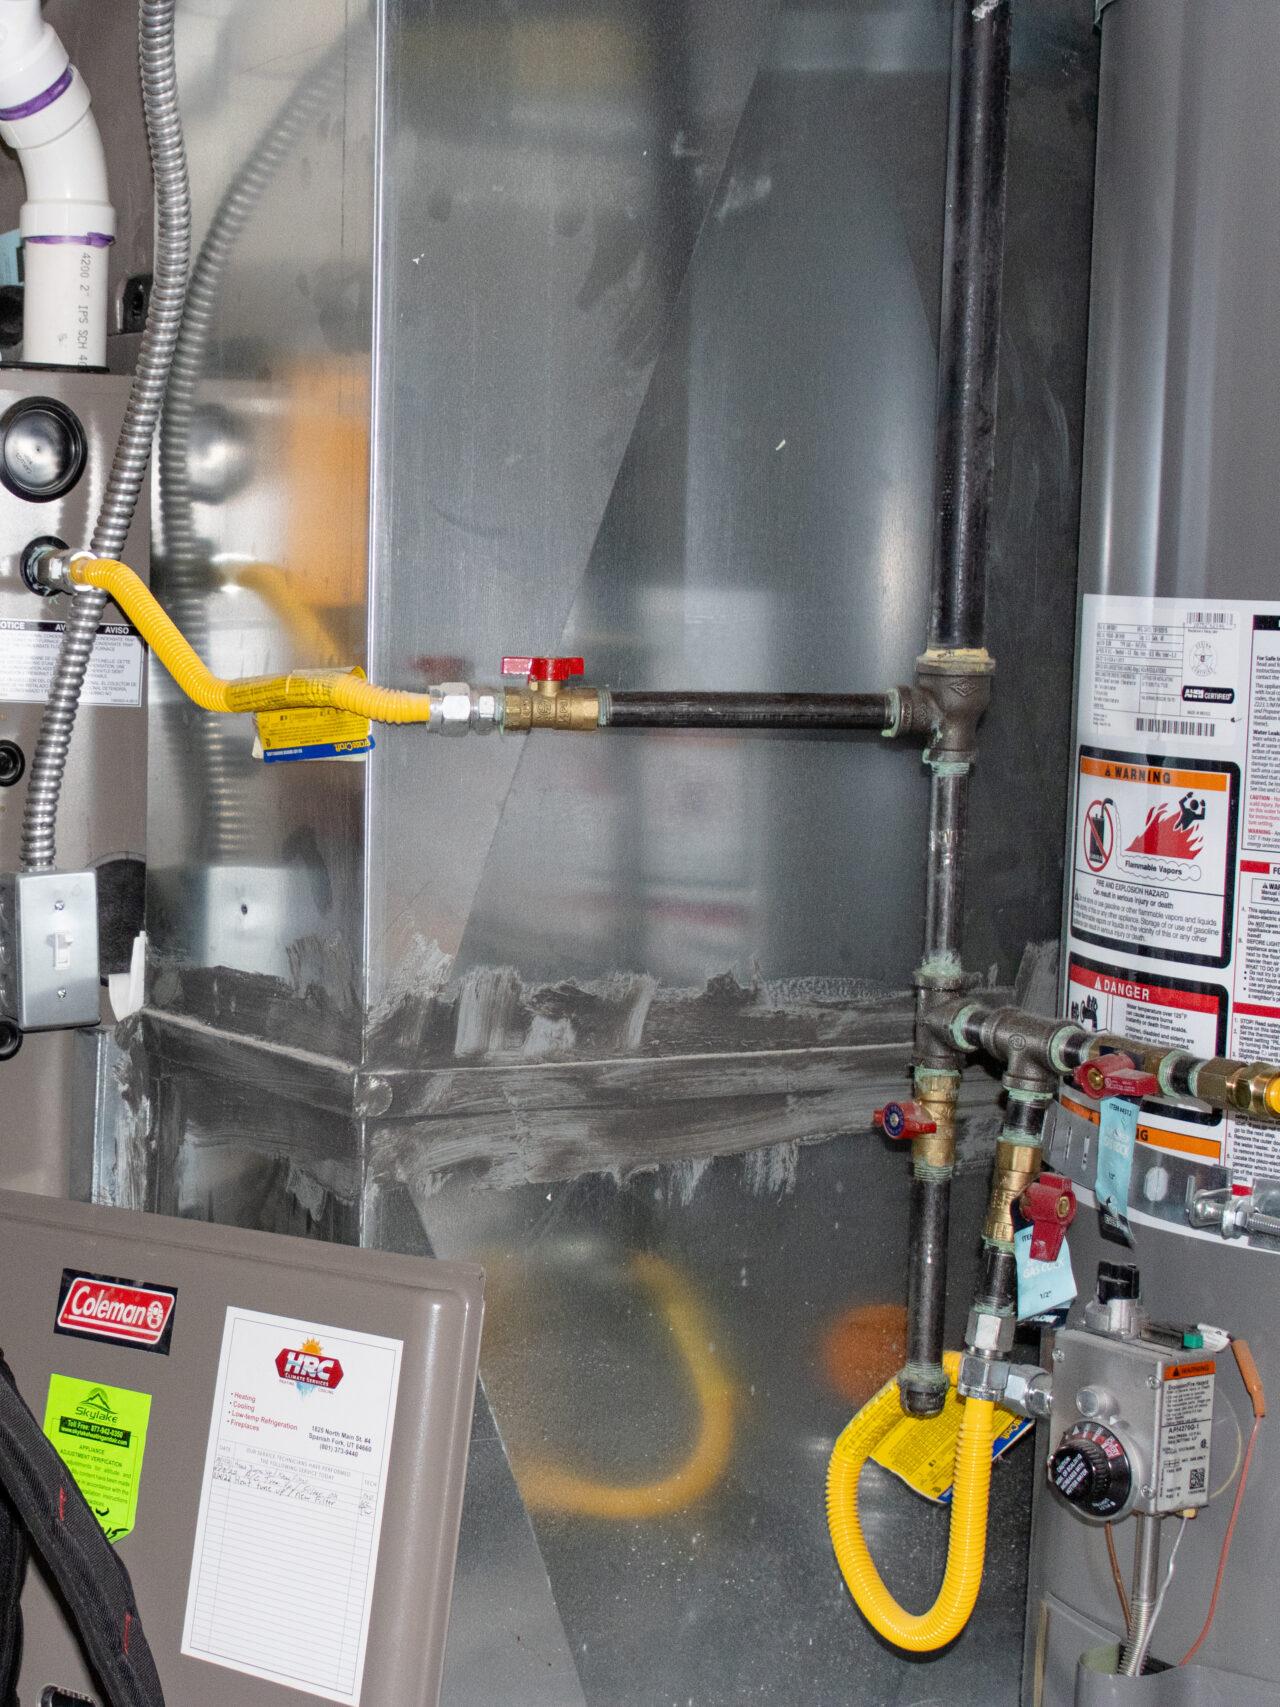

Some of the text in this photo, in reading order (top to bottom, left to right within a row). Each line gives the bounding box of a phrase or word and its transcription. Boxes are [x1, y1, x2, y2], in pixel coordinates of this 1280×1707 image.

[80, 252, 91, 278] 4200
[78, 305, 88, 324] IPS
[77, 330, 88, 349] SCH
[105, 626, 129, 634] AVISO
[1204, 690, 1230, 700] CERTIFIED
[1114, 764, 1171, 784] WARNING
[1125, 860, 1182, 876] Flammable Vapors
[1096, 879, 1104, 887] FIRE
[1115, 883, 1143, 894] EXPLOSION
[1145, 888, 1169, 898] HAZARD
[1135, 897, 1148, 907] injury
[1158, 901, 1173, 909] death
[1139, 909, 1163, 919] flammable
[1165, 914, 1183, 922] vapors
[1185, 916, 1196, 924] and
[1197, 917, 1216, 926] liquids
[1140, 917, 1160, 928] Storage
[1194, 927, 1219, 936] gasoline
[1162, 930, 1171, 938] this
[1180, 934, 1190, 942] any
[1104, 979, 1150, 1001] DANGER
[1138, 1005, 1162, 1014] temperature
[1143, 1028, 1160, 1037] disabled
[1170, 1034, 1186, 1043] elderly
[1040, 1290, 1052, 1299] 1/2"
[71, 1285, 146, 1326] Coleman
[284, 1352, 335, 1380] HRC
[1181, 1364, 1210, 1374] WARNING
[285, 1373, 329, 1386] CLIMATE SERVICES
[234, 1392, 256, 1403] Heating
[233, 1401, 255, 1412] Cooling
[75, 1406, 118, 1423] Skylake
[232, 1410, 297, 1430] Low-temp Refrigeration
[68, 1419, 77, 1427] Toll
[230, 1419, 259, 1431] Fireplaces
[309, 1433, 330, 1442] Spanish
[325, 1428, 340, 1437] North
[341, 1432, 354, 1440] Main
[80, 1444, 104, 1455] APPLIANCE
[320, 1443, 358, 1457] (801) 373-9440
[60, 1449, 122, 1467] ADJUSTMENT VERIFICATION
[258, 1450, 275, 1459] SERVICE
[277, 1454, 307, 1467] TECHNICIANS
[322, 1465, 351, 1477] PERFORMED
[1066, 1453, 1082, 1470] SCALDING
[270, 1460, 297, 1471] FOLLOWING
[299, 1468, 317, 1476] SERVICE
[319, 1472, 334, 1480] TODAY
[1060, 1462, 1085, 1490] INCREASES WITH
[1076, 1468, 1088, 1482] WATER
[365, 1479, 377, 1487] TECH
